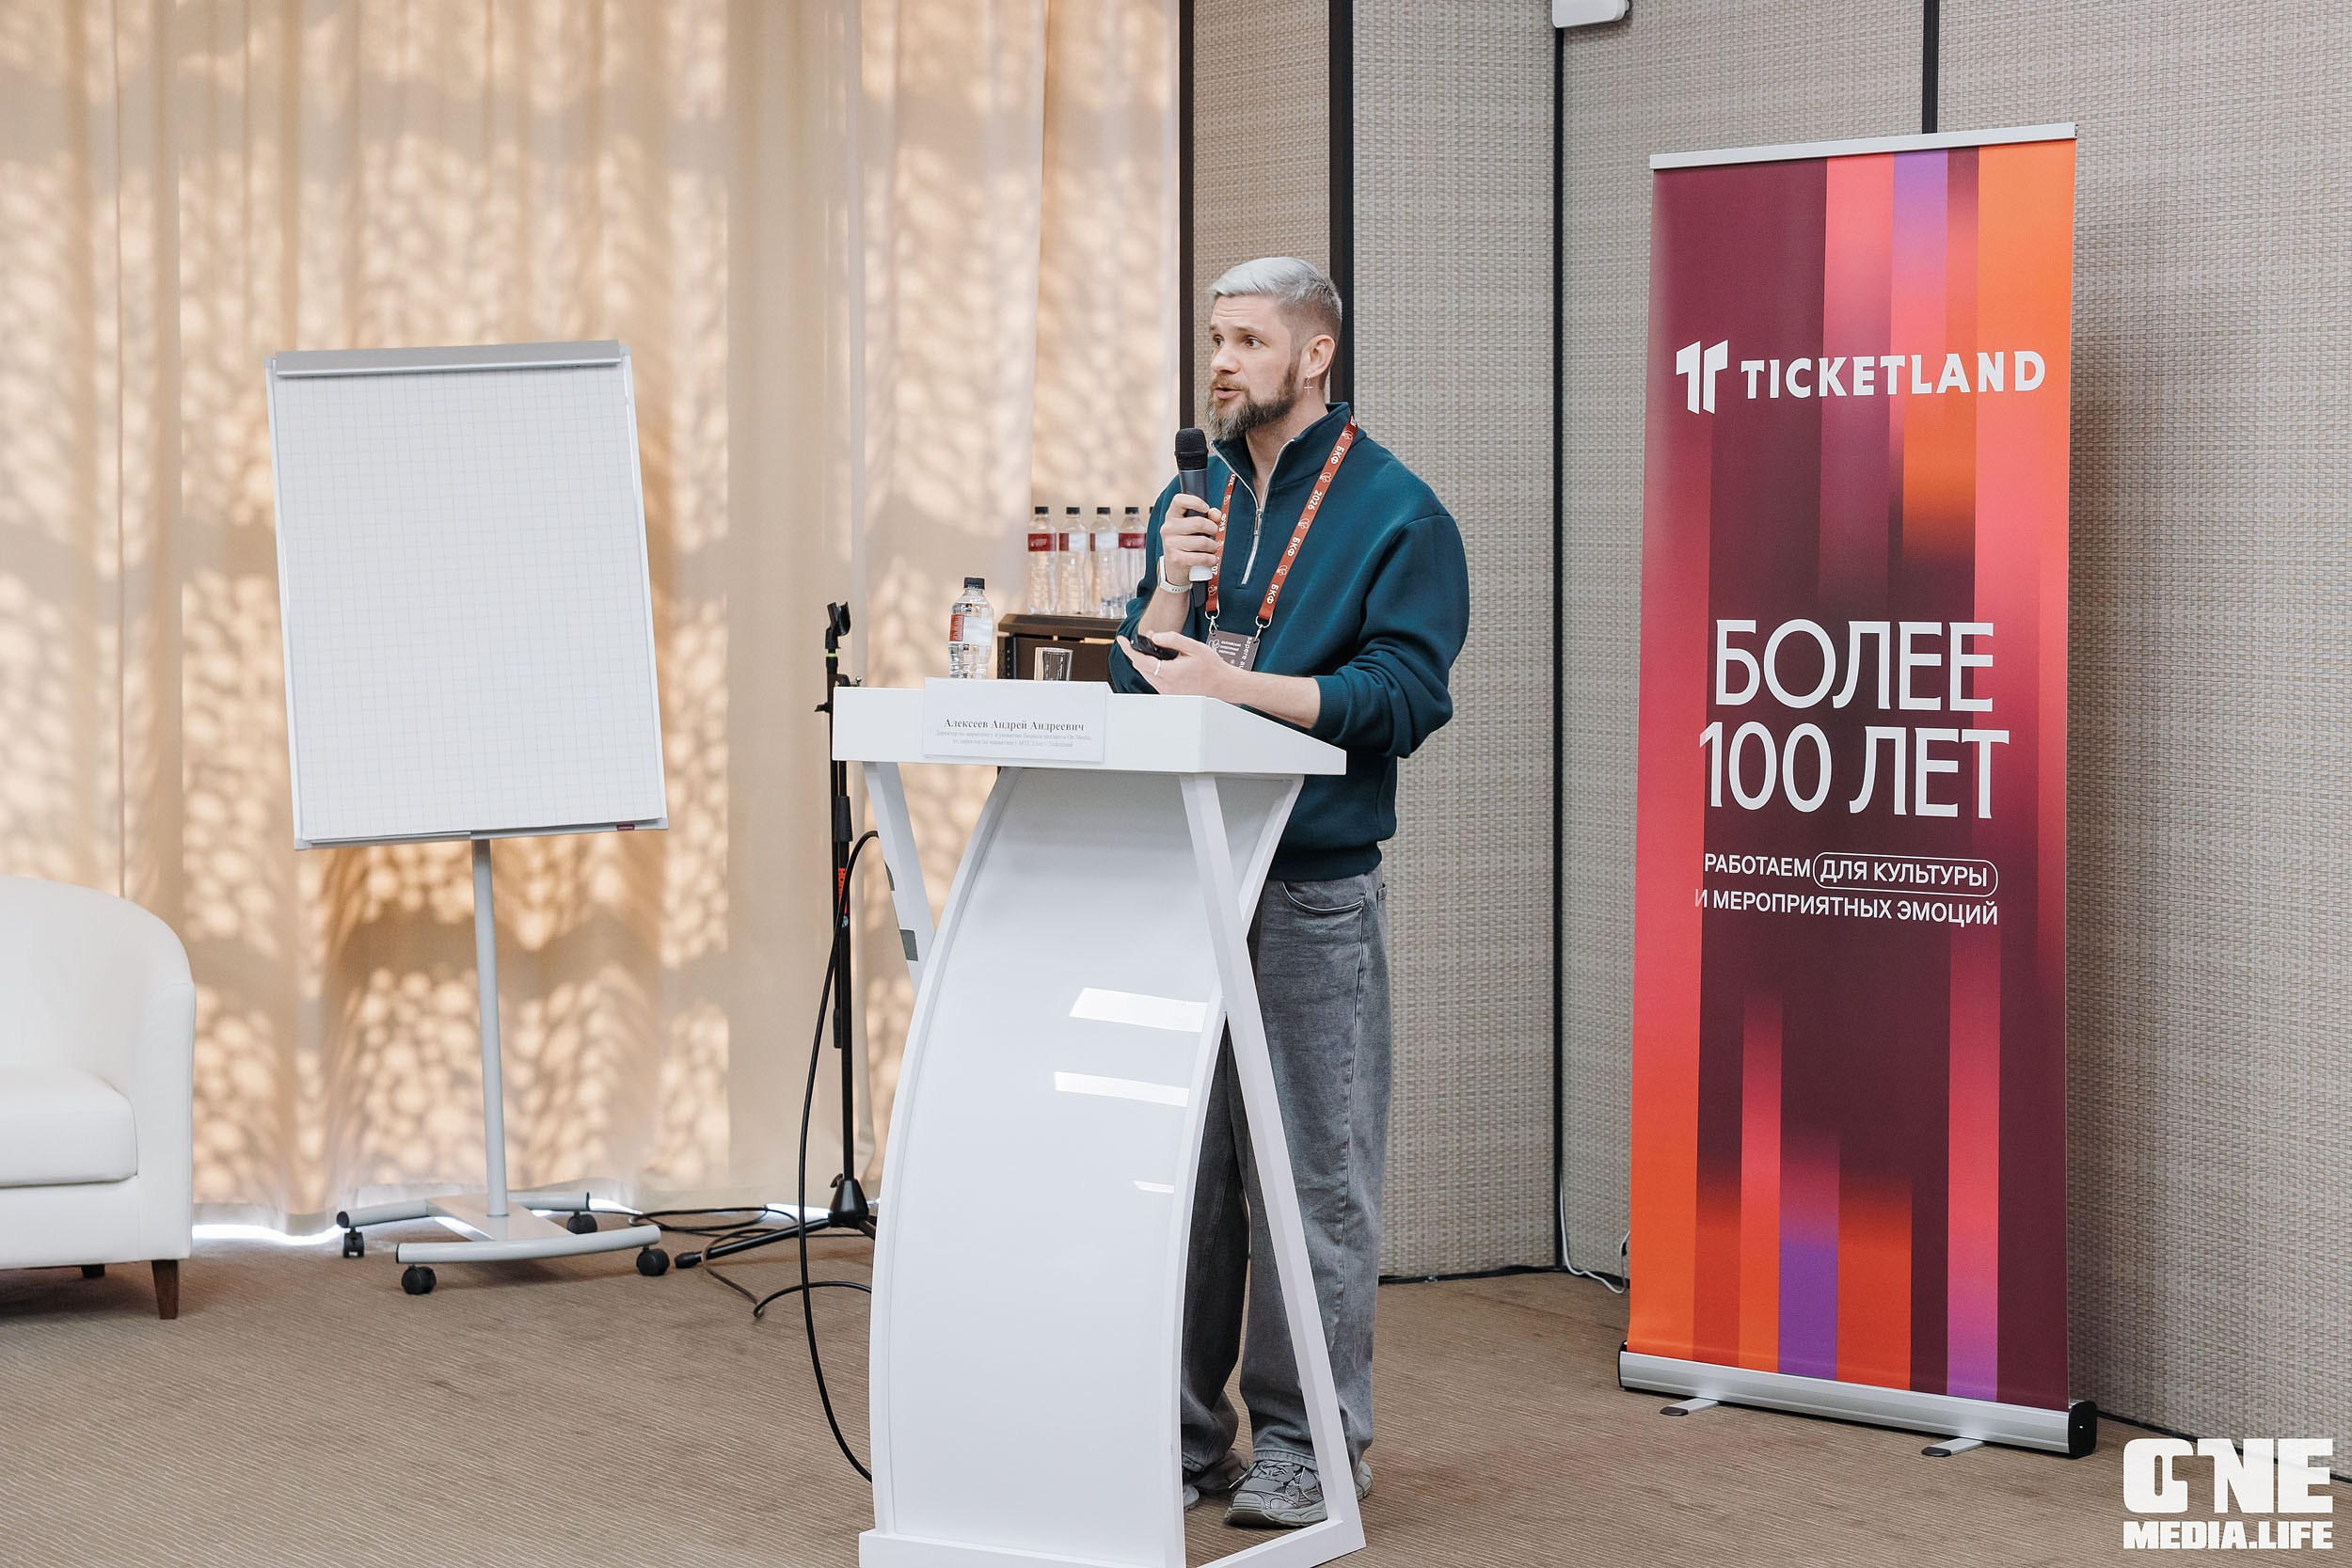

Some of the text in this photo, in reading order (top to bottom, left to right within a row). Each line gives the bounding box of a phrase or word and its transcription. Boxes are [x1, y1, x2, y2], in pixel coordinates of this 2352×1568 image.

[1740, 350, 2046, 399] TICKETLAND
[1330, 445, 1345, 465] БКФ
[1307, 489, 1323, 511] 2026
[1286, 536, 1301, 557] БКФ
[1266, 583, 1279, 604] БКФ
[1715, 619, 1994, 712] БОЛЕЕ
[944, 718, 1085, 733] Алексеев Андрей Андреевич
[1699, 721, 2010, 819] 100 ЛЕТ
[1704, 853, 1987, 887] РАБОТАЕМ ДЛЯ КУЛЬТУРЫ
[1694, 889, 1998, 927] И МЕРОПРИЯТНЫХ ЭМОЦИЙ
